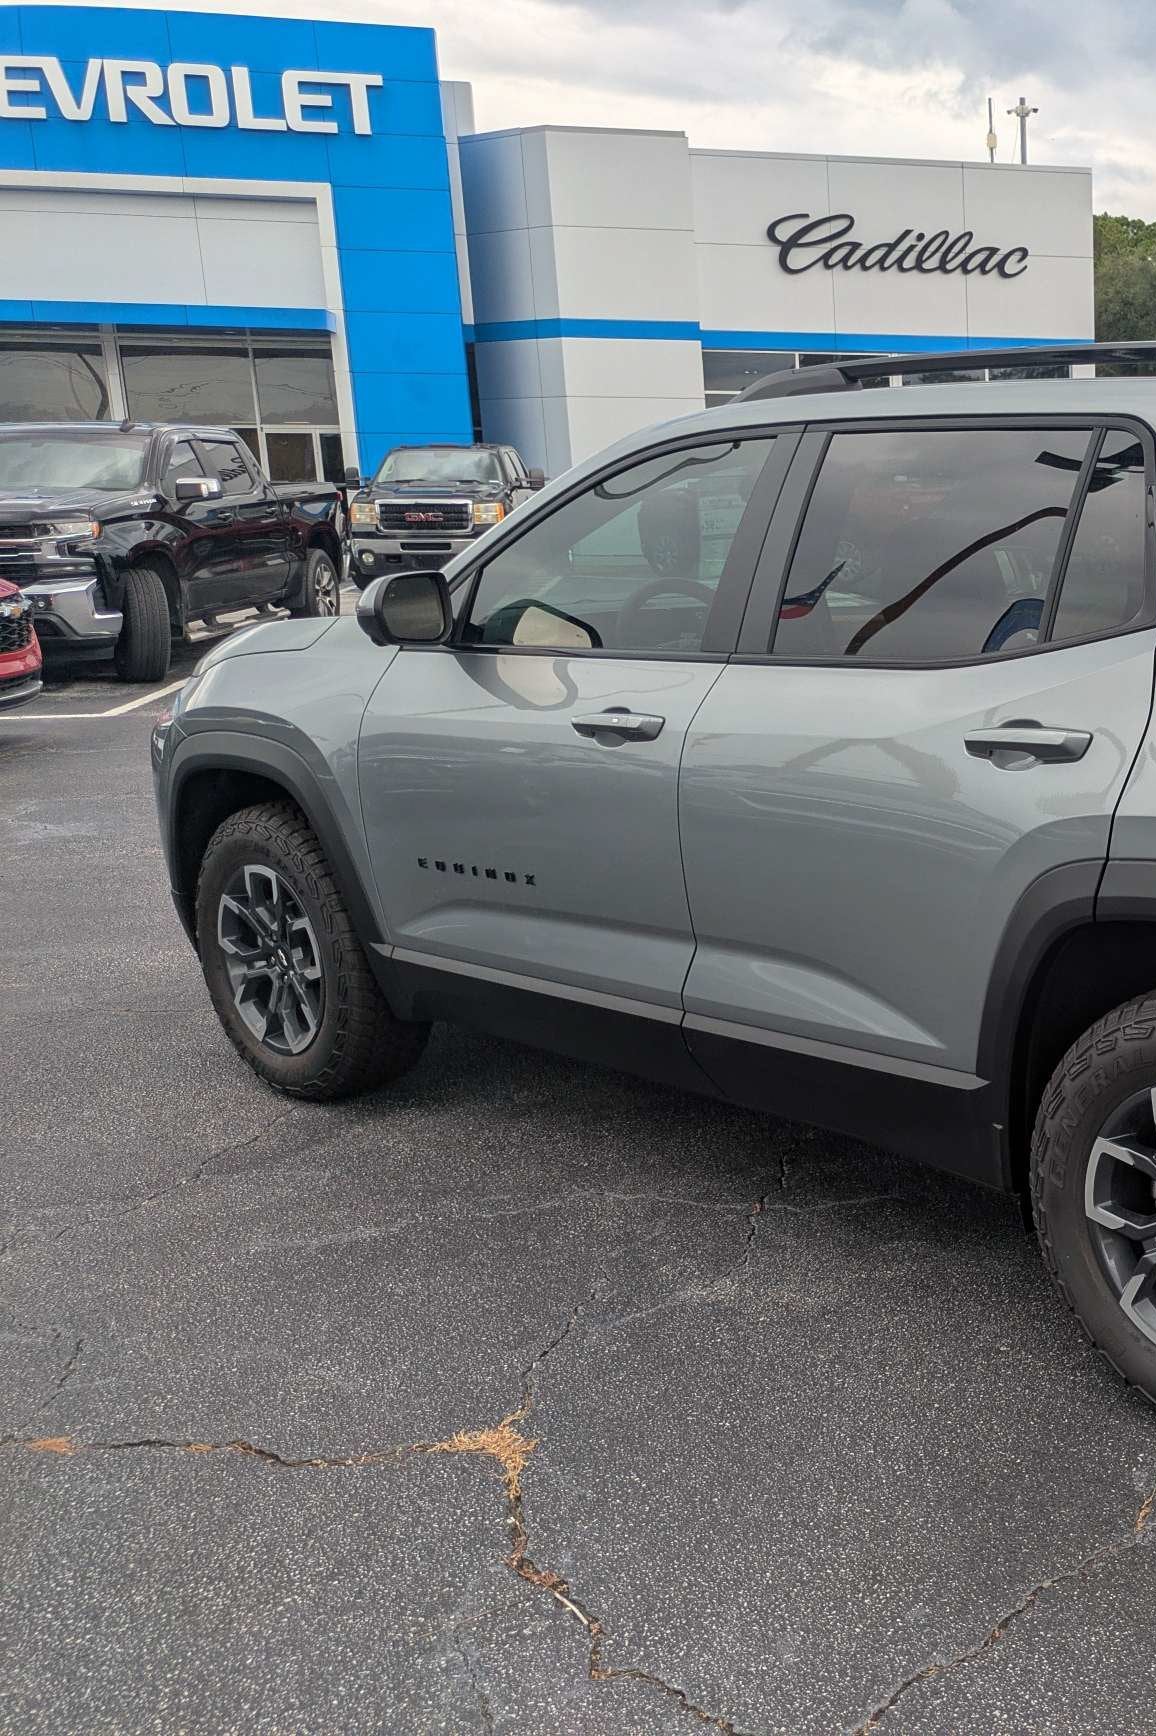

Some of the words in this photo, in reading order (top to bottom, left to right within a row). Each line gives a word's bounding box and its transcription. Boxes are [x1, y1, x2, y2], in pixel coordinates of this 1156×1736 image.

[766, 213, 1029, 279] Cadillac
[404, 512, 443, 523] GMC
[417, 857, 536, 887] EQUINOX
